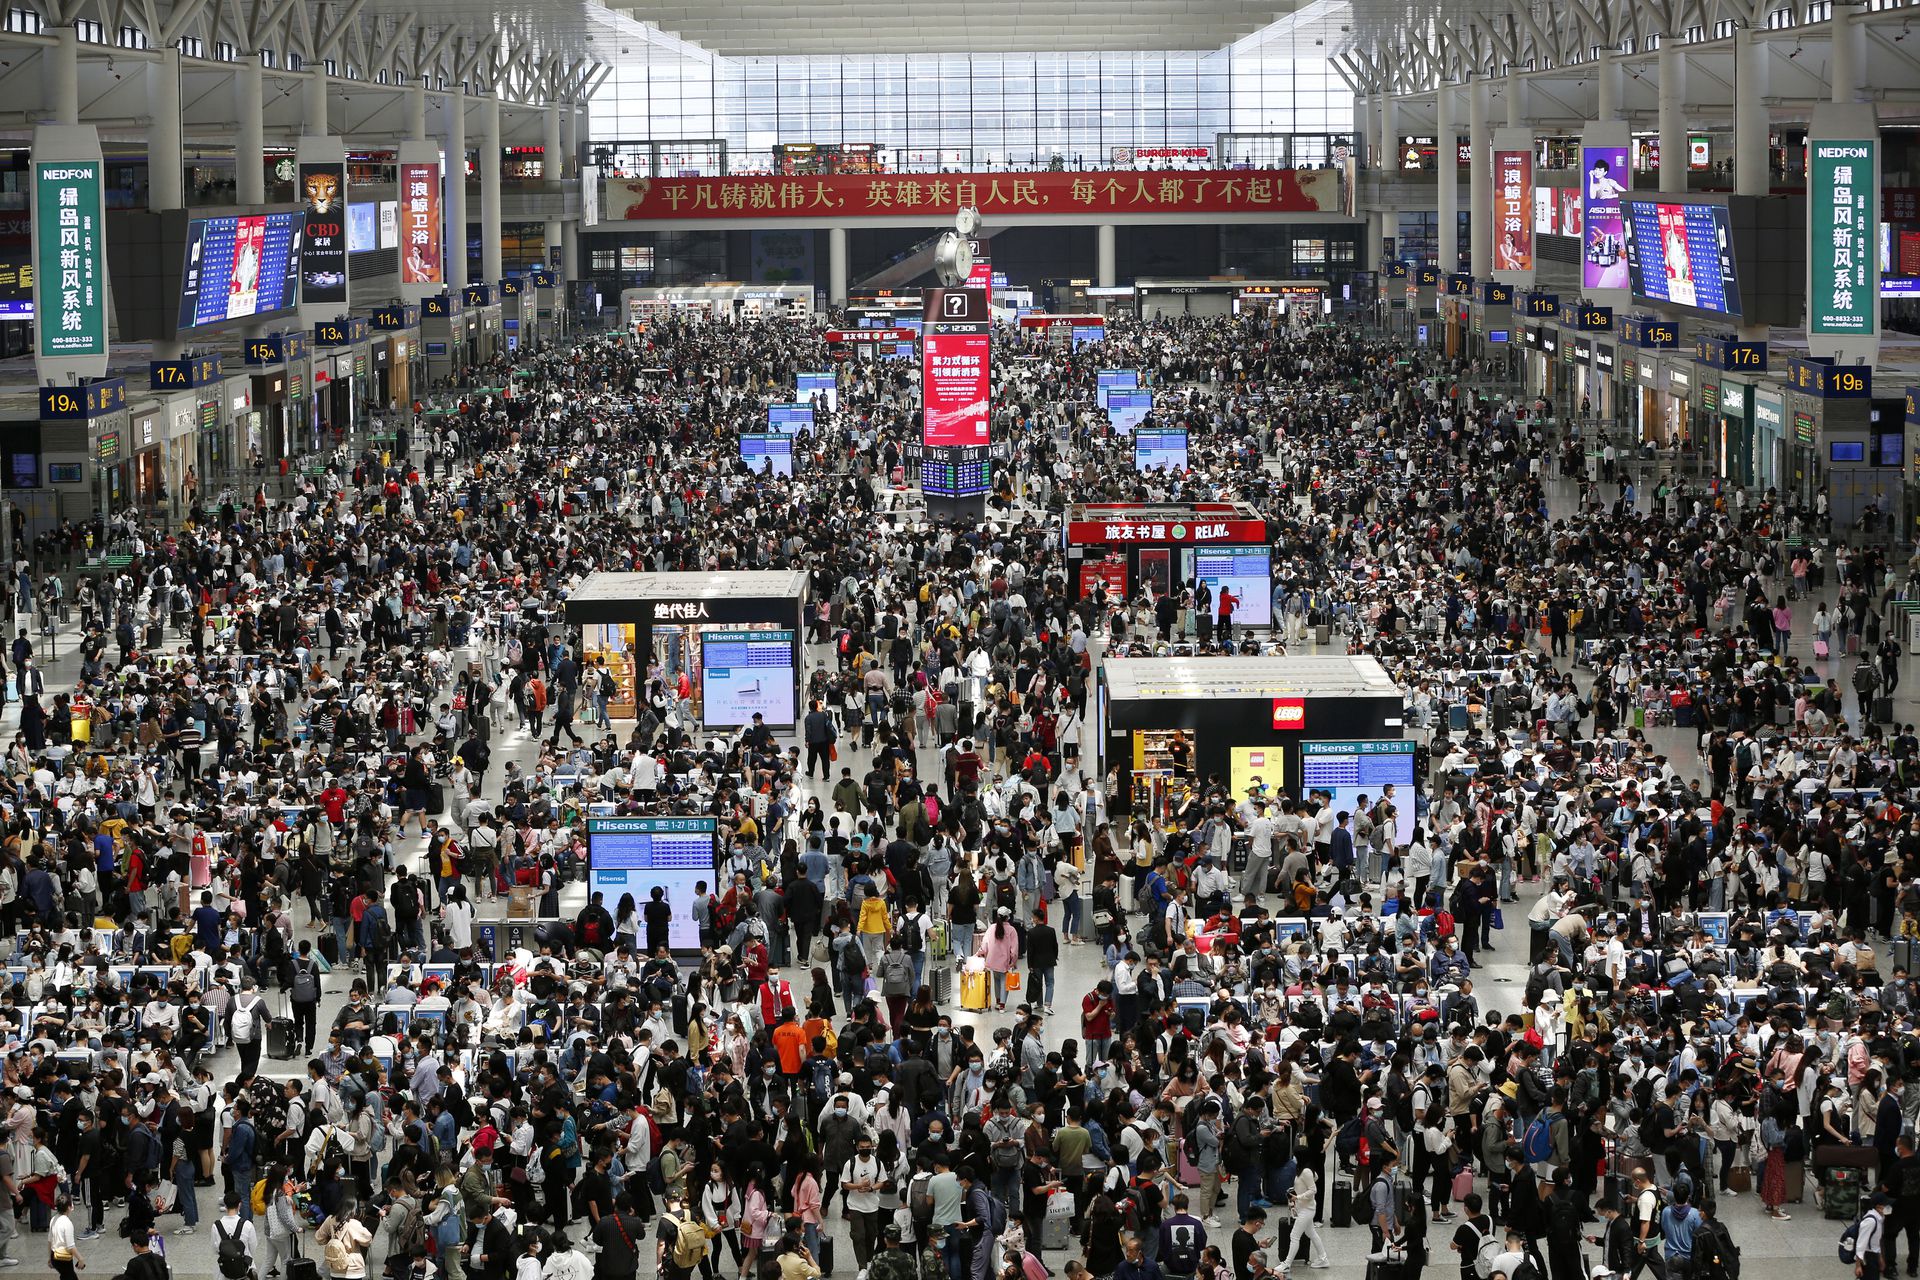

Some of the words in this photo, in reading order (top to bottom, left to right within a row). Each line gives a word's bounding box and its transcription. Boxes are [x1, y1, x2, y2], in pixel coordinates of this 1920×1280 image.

[1136, 148, 1178, 158] BURGER
[1181, 148, 1208, 158] KING
[1818, 147, 1868, 158] NEDFON
[43, 169, 93, 180] NEDFON
[661, 181, 845, 211] 平凡铸就伟大，
[865, 179, 1051, 208] 英雄来自人民，
[1069, 177, 1283, 206] 每个人都了不起！
[1503, 169, 1522, 232] 浪鲸卫浴
[410, 181, 429, 245] 浪鲸卫浴
[1588, 206, 1606, 214] ASD
[306, 223, 340, 237] CBD
[314, 237, 331, 247] 家居
[1832, 165, 1853, 310] 绿岛风新风系统
[59, 187, 82, 331] 绿岛风新风系统
[1394, 265, 1405, 275] 3B
[537, 276, 548, 285] 3A
[1423, 272, 1435, 282] 5B
[505, 283, 517, 293] 5A
[1455, 281, 1468, 291] 7B
[468, 292, 482, 302] 7A
[1493, 289, 1506, 301] 9B
[428, 302, 442, 313] 9A
[1532, 300, 1554, 312] 11B
[378, 313, 398, 325] 11A
[1584, 312, 1607, 325] 13B
[320, 327, 343, 340] 13A
[1647, 328, 1673, 342] 15B
[51, 336, 93, 344] 400-8832-333
[250, 344, 276, 359] 15A
[1731, 348, 1760, 364] 17B
[157, 367, 186, 384] 17A
[1832, 373, 1864, 391] 19B
[47, 394, 79, 412] 19A
[1105, 524, 1166, 540] 旅友书屋
[653, 602, 710, 620] 绝代佳人
[1275, 706, 1303, 721] LEGO
[1309, 743, 1355, 753] Hisense
[596, 821, 648, 830] Hisense
[671, 821, 685, 829] 1-27
